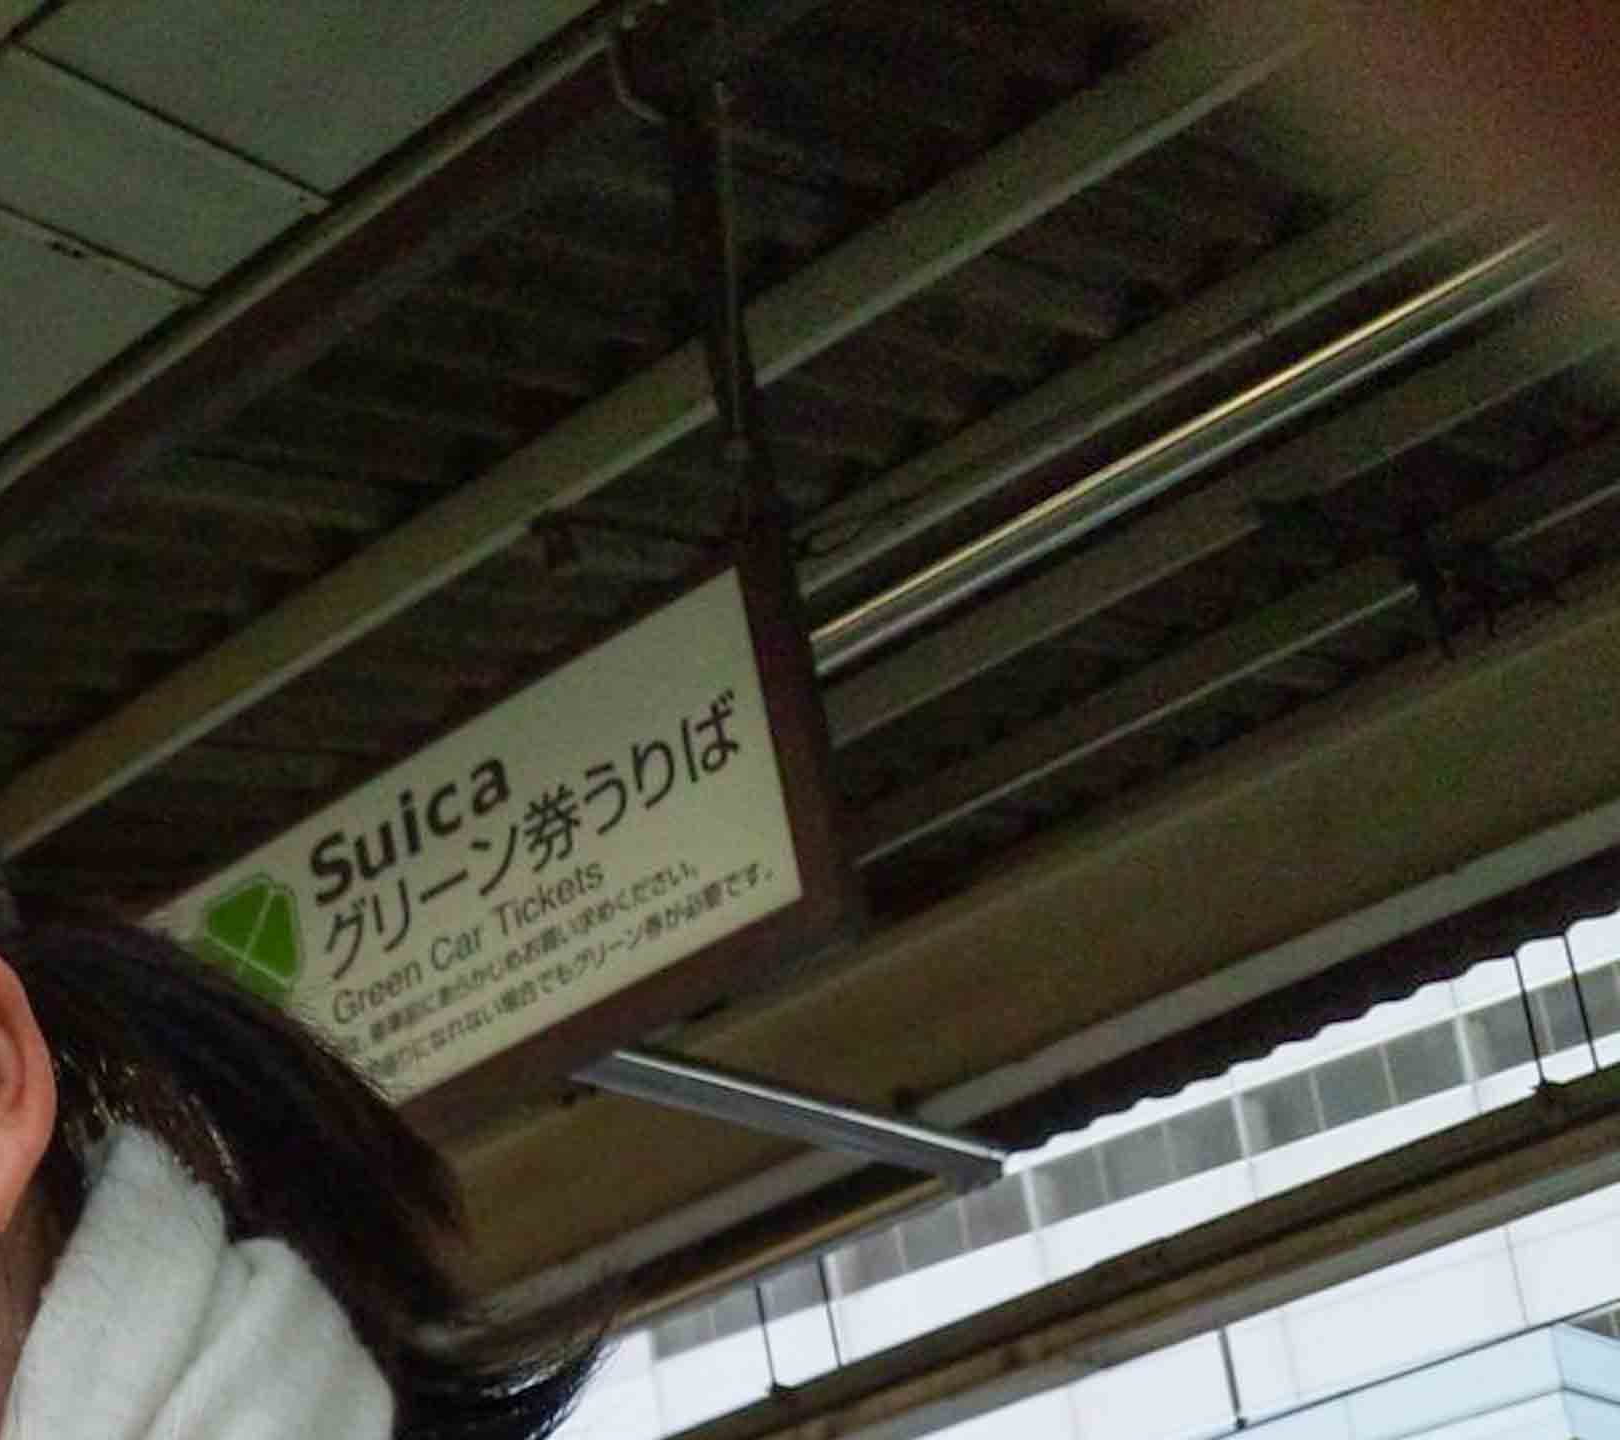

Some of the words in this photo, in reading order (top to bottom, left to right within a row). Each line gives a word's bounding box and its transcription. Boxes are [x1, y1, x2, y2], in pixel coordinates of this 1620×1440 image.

[310, 758, 511, 907] Suica
[324, 689, 740, 983] グリーン券うりば
[332, 960, 424, 1025] Green
[430, 922, 483, 972] Car
[492, 862, 605, 937] Tickets
